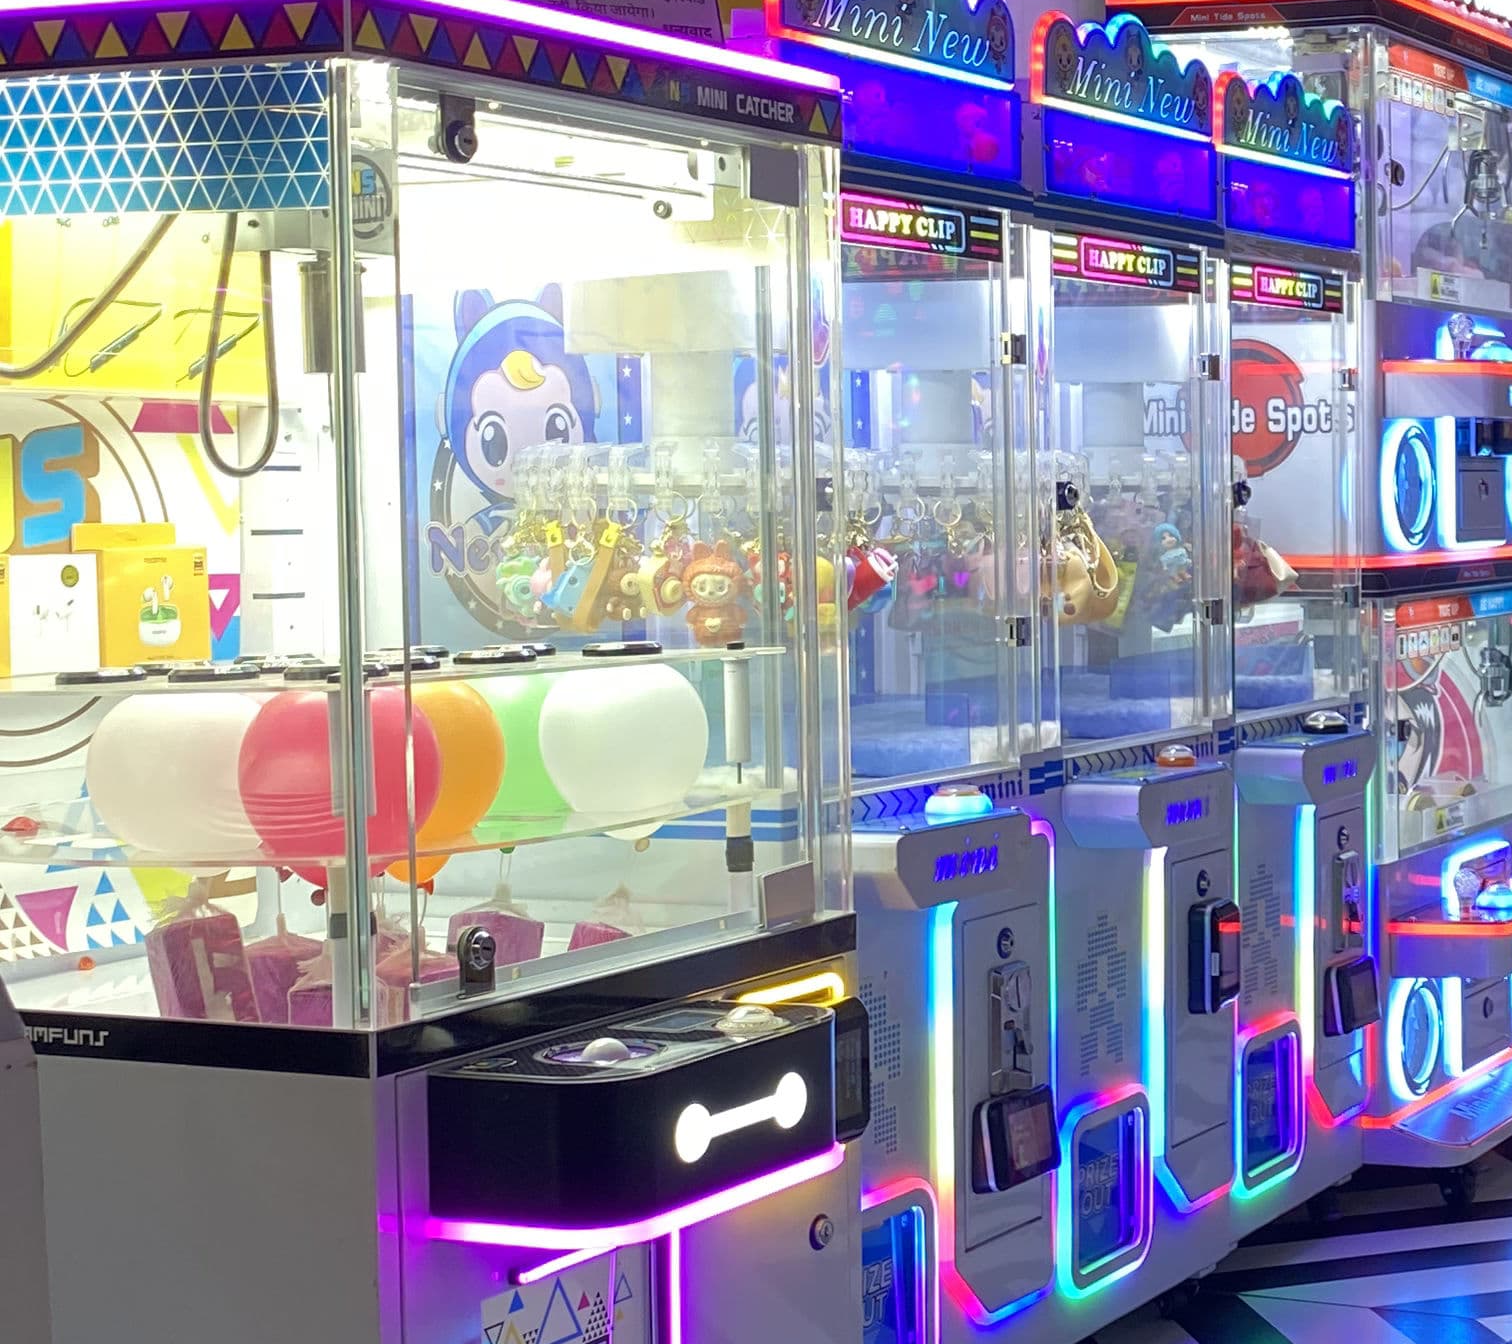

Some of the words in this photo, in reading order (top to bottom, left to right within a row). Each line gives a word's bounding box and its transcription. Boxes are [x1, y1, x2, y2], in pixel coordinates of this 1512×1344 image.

[912, 7, 990, 69] New
[697, 86, 728, 111] MINI
[736, 93, 795, 123] CATCHER
[1066, 55, 1135, 107] Mini
[1137, 76, 1197, 124] New
[1240, 109, 1292, 152] Mini
[1294, 122, 1340, 164] New
[850, 206, 914, 237] HAPPY
[915, 215, 957, 241] CLIP
[1089, 248, 1136, 273] HAPPY
[1137, 254, 1168, 277] CLIP
[1260, 275, 1296, 296] HAPPY
[1296, 279, 1319, 300] CLIP
[1267, 398, 1355, 441] Spots
[428, 521, 508, 577] Ne
[1078, 1153, 1119, 1188] PRIZE
[1081, 1182, 1113, 1217] OUT
[862, 1256, 892, 1289] IZE
